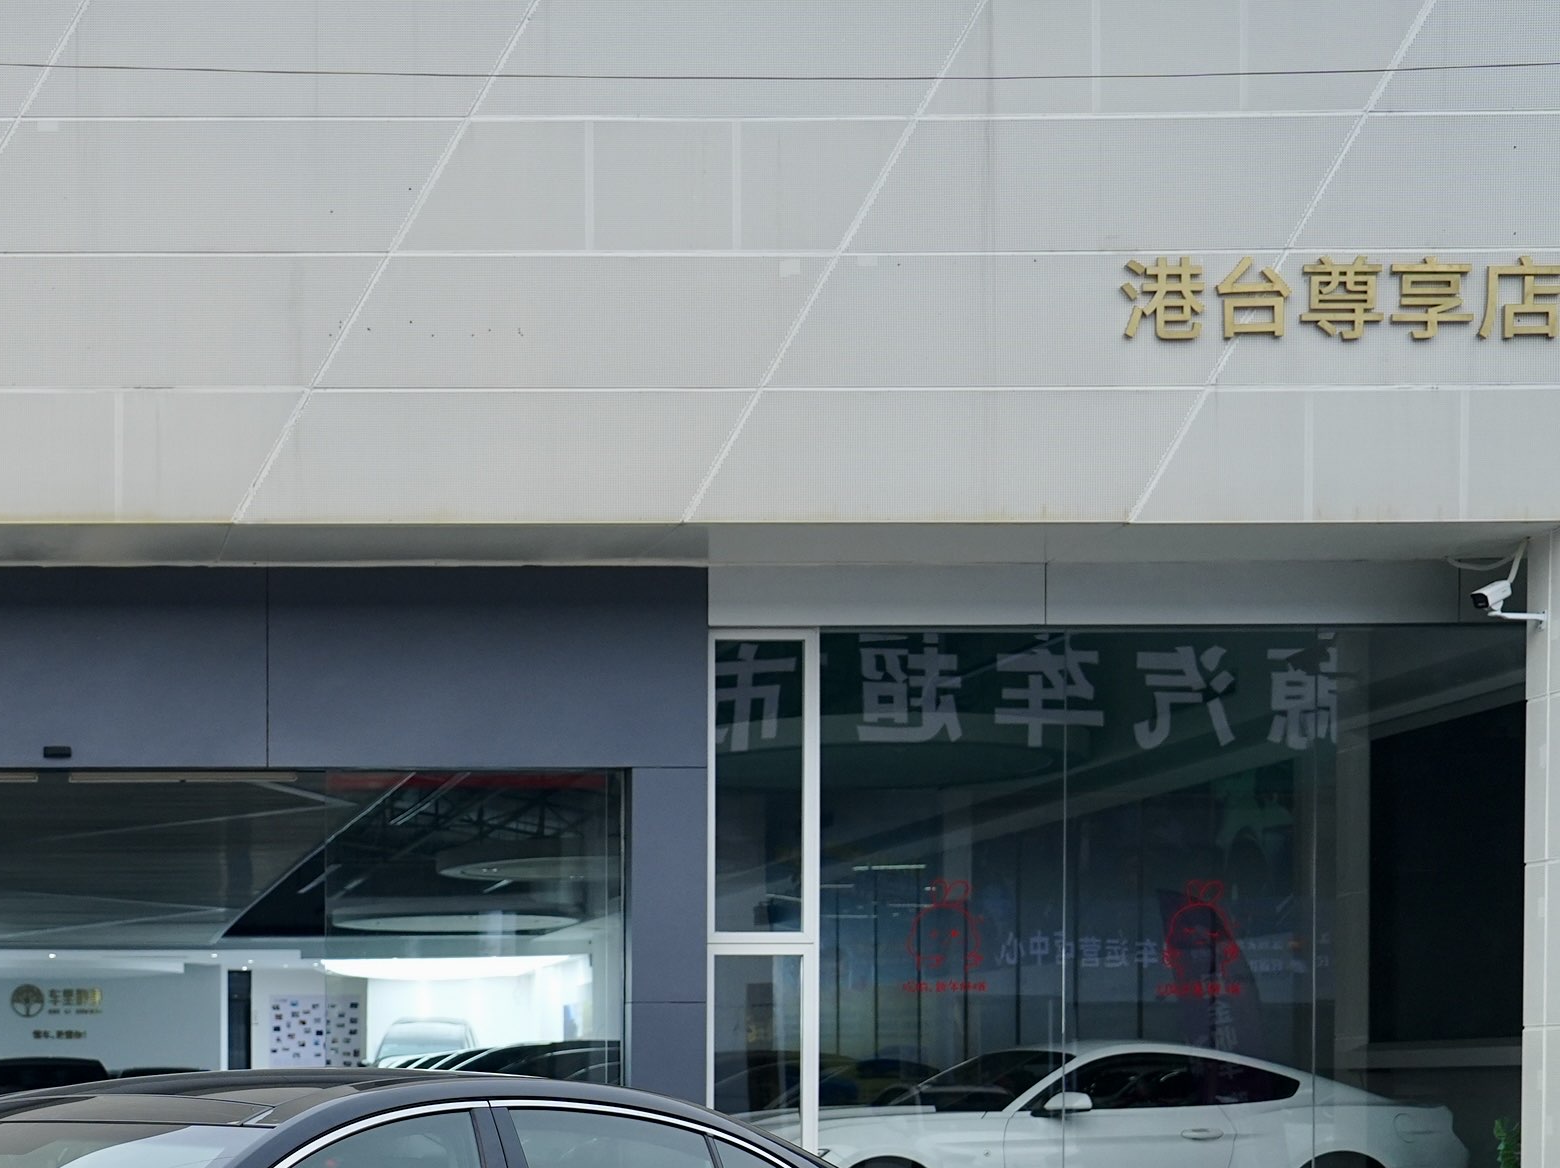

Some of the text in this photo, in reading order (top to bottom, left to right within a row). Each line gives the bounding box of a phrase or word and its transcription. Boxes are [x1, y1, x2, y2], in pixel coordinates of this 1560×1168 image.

[1120, 256, 1560, 341] 港台尊享店
